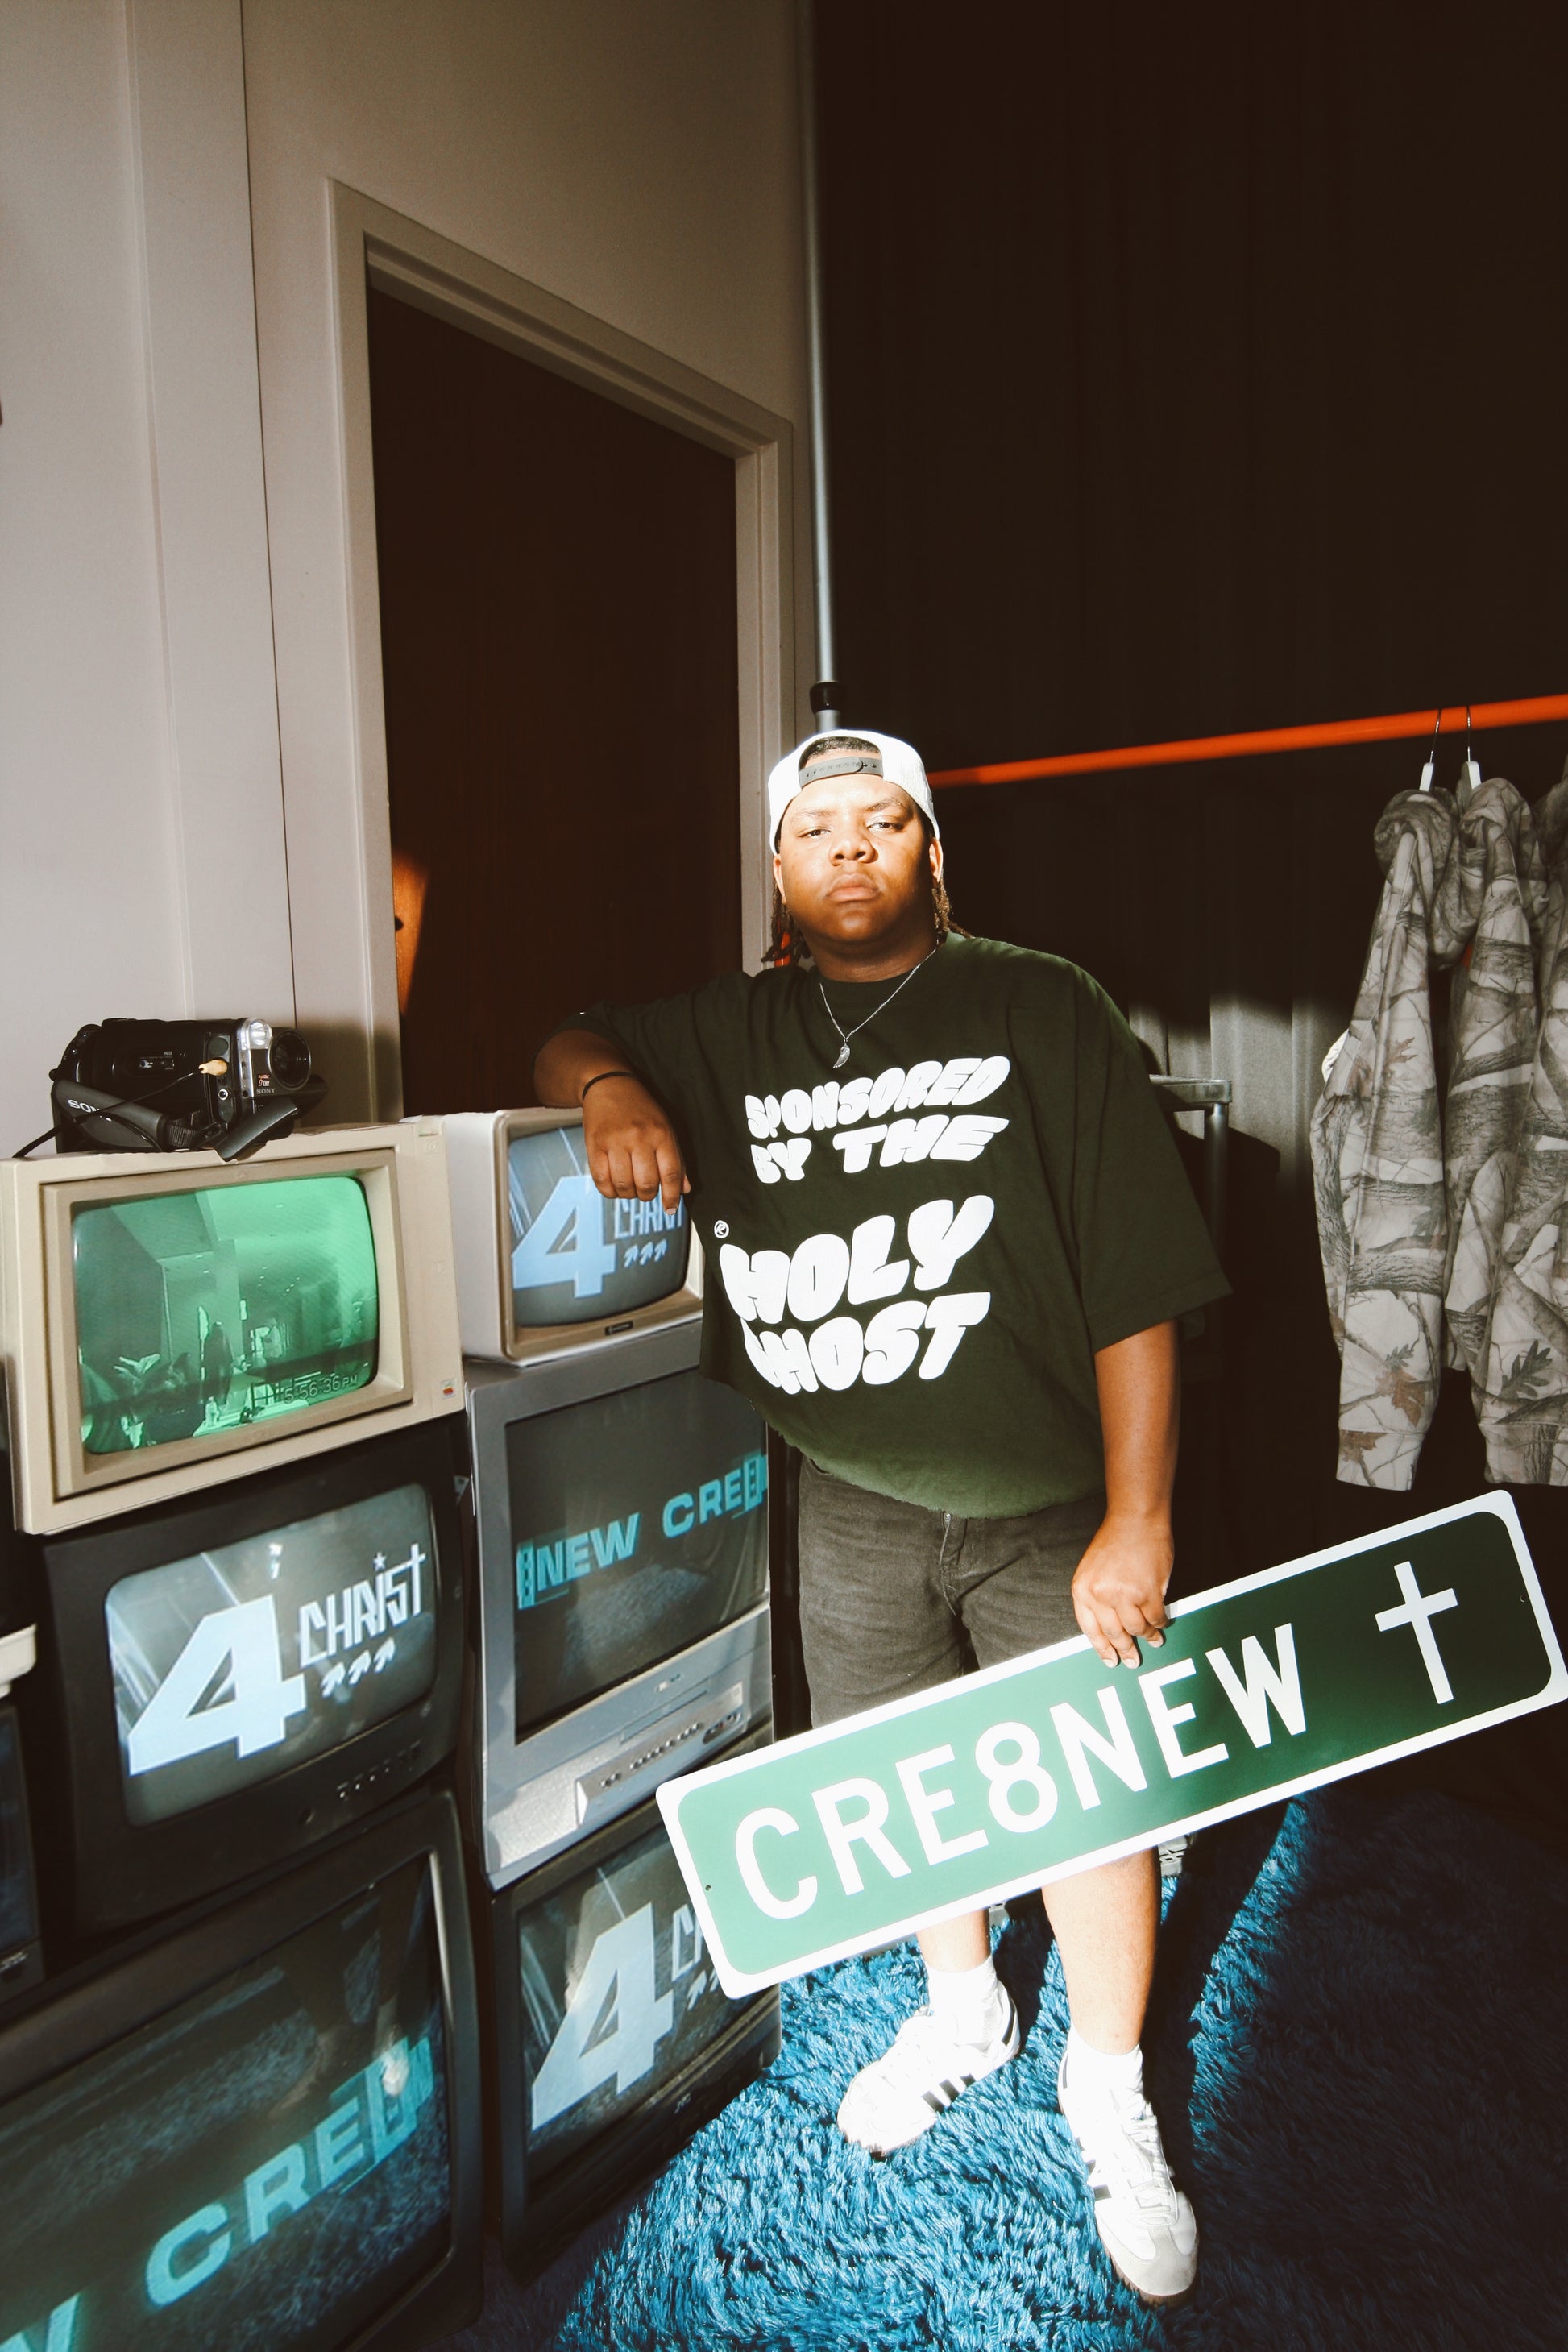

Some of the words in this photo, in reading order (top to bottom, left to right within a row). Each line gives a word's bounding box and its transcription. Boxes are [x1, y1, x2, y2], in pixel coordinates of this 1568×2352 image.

[745, 1056, 1010, 1139] SPONSORED
[751, 1138, 811, 1184] BY
[832, 1114, 1009, 1174] THE
[512, 1175, 616, 1298] 4
[720, 1195, 995, 1324] HOLY
[284, 1375, 340, 1404] 5:56:36
[342, 1375, 358, 1388] PM
[128, 1594, 306, 1776] 4
[735, 1623, 1306, 1919] CRE8NEW
[532, 1902, 674, 2132] 4
